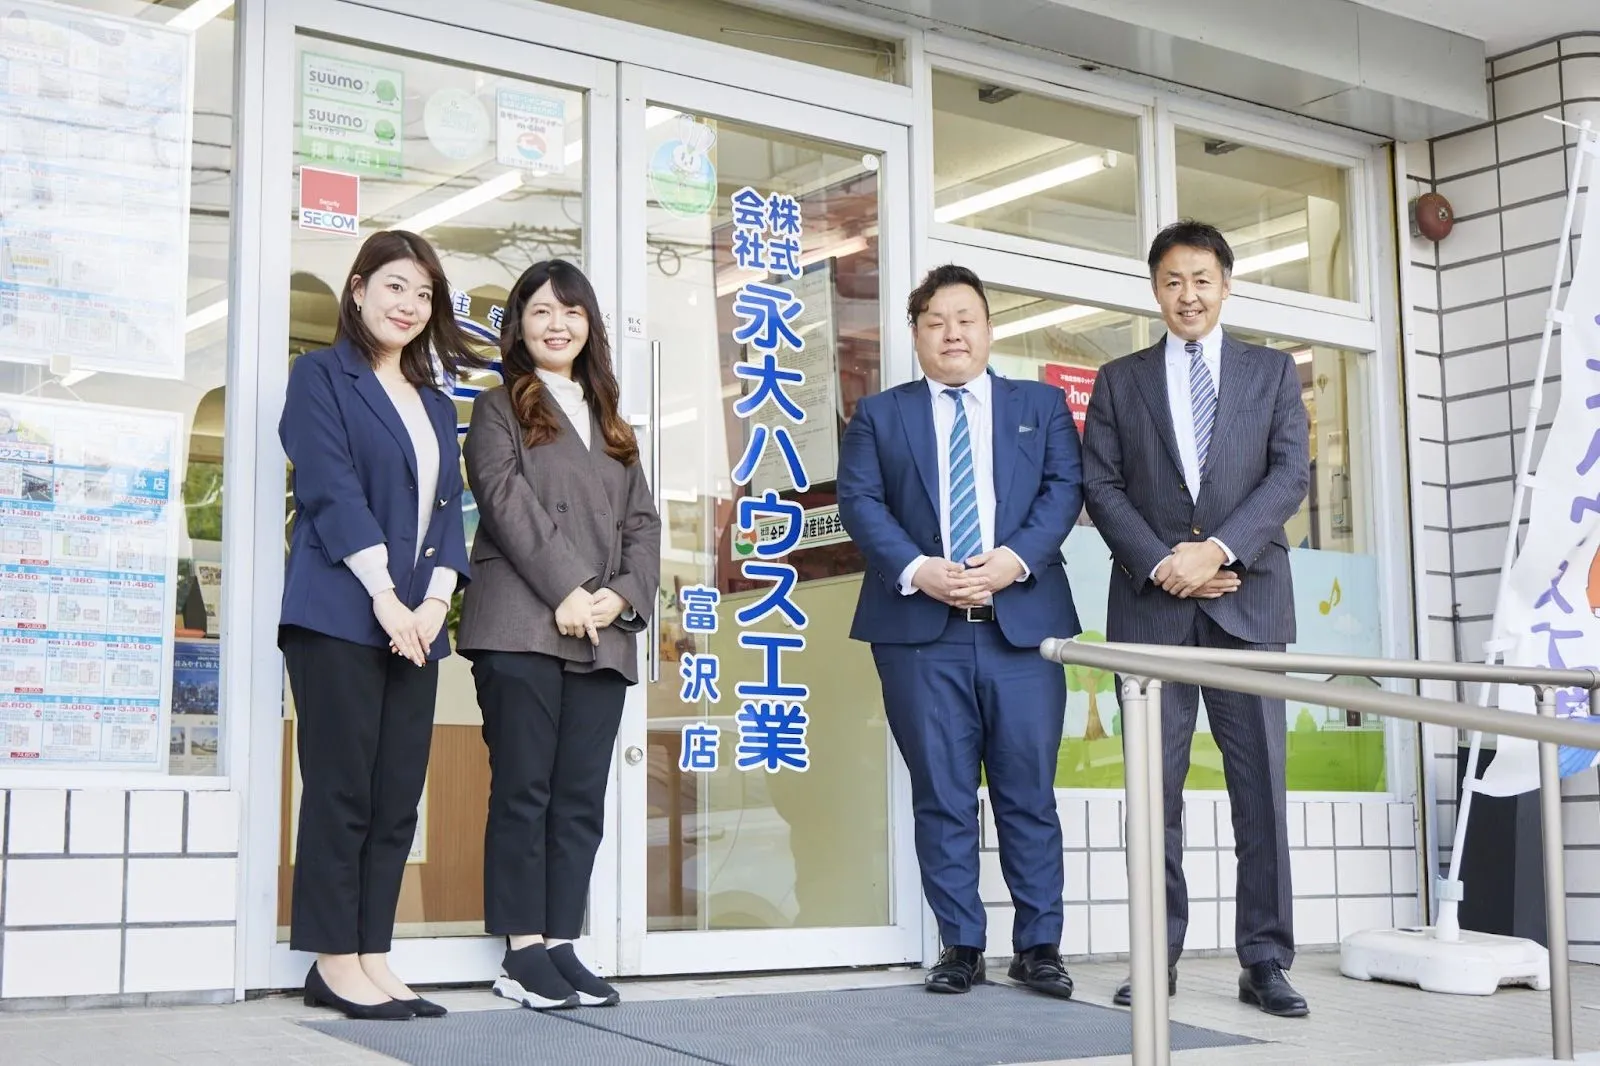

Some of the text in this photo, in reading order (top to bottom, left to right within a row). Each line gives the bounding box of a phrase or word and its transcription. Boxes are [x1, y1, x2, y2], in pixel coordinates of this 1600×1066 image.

[303, 210, 355, 231] SECOM
[733, 282, 809, 771] 永大ハウス工業
[680, 586, 719, 769] 富沢店
